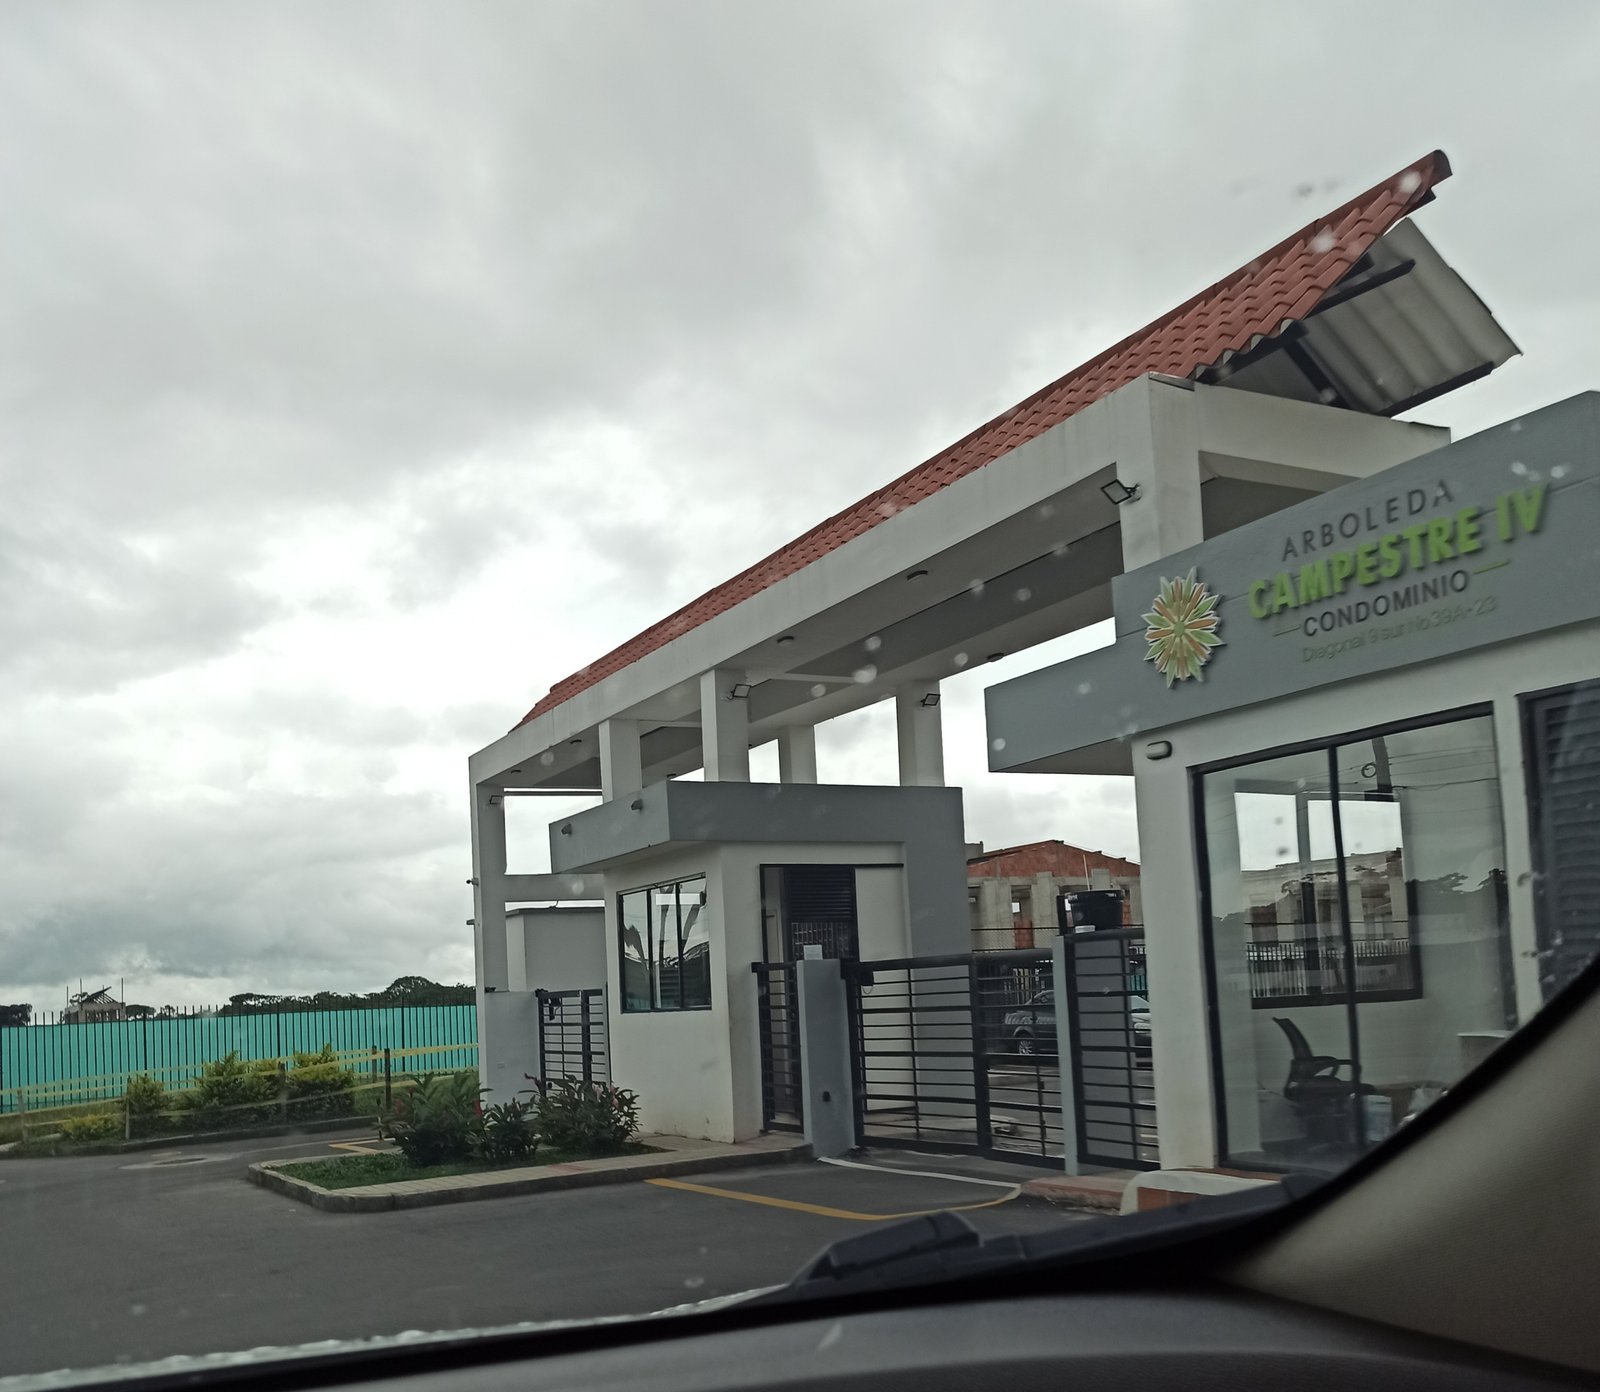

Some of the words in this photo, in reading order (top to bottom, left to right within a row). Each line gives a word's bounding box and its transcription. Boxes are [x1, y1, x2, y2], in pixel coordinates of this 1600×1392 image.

[1250, 506, 1484, 620] CAMPESTRE
[1495, 484, 1550, 543] IV
[1281, 479, 1454, 562] ARBOLEDA
[1303, 569, 1471, 637] CONDOMINIO
